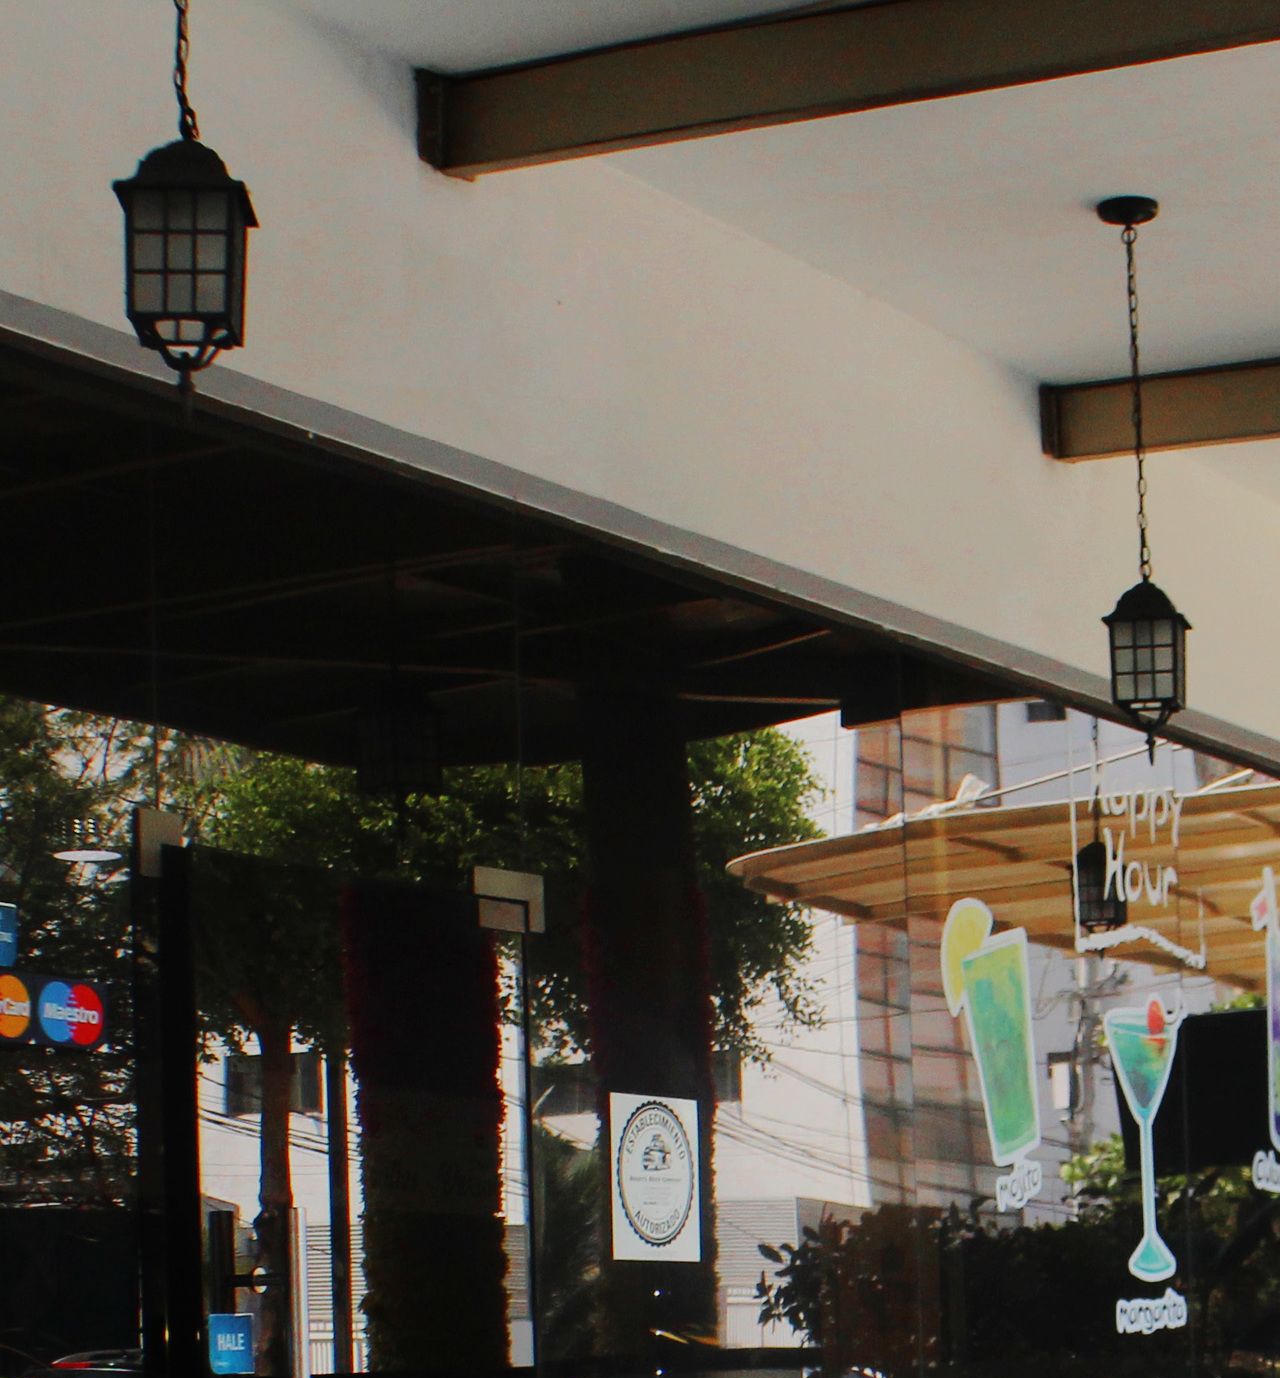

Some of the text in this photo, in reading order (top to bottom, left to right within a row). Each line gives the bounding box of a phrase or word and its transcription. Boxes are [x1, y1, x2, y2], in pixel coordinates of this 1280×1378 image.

[1102, 827, 1179, 908] Hour
[43, 1002, 99, 1025] Maestro
[626, 1113, 686, 1160] ESTABLECIMIENTO
[634, 1210, 680, 1235] AUTORIZADO
[217, 1333, 245, 1351] HALE
